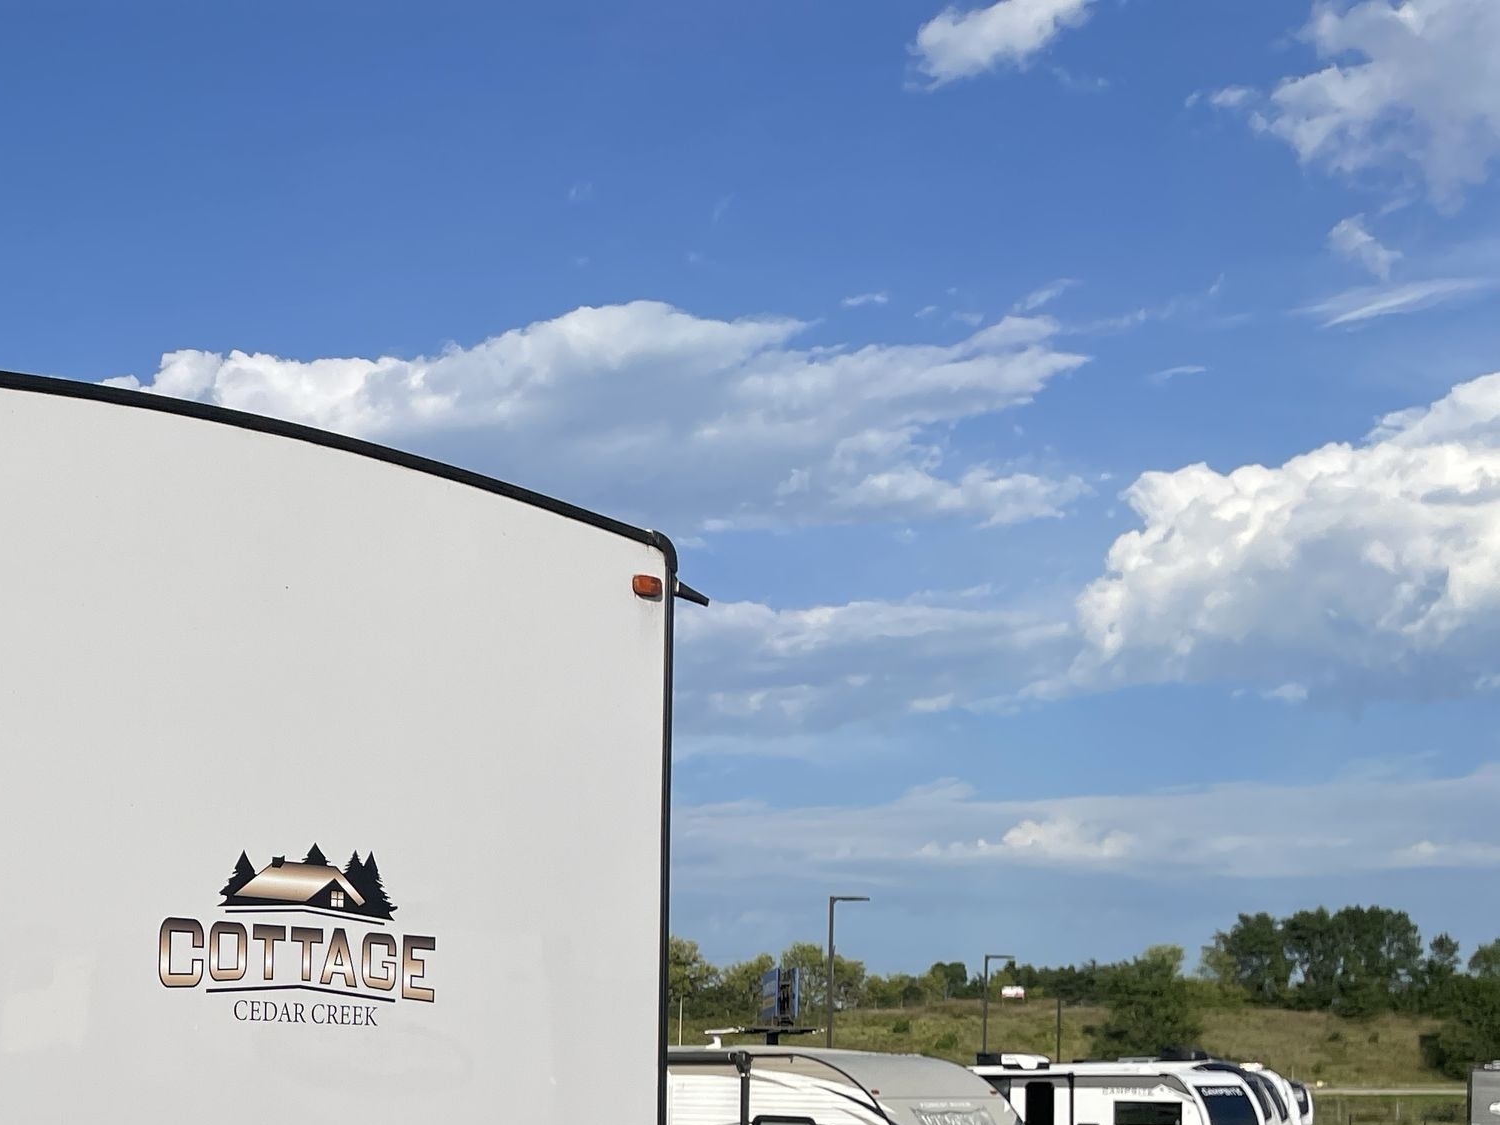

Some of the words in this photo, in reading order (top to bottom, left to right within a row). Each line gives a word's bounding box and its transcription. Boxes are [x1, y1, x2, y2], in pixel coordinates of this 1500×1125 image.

[158, 917, 436, 1003] COTTAGE
[233, 1000, 306, 1024] CEDAR
[311, 1003, 378, 1026] CREEK
